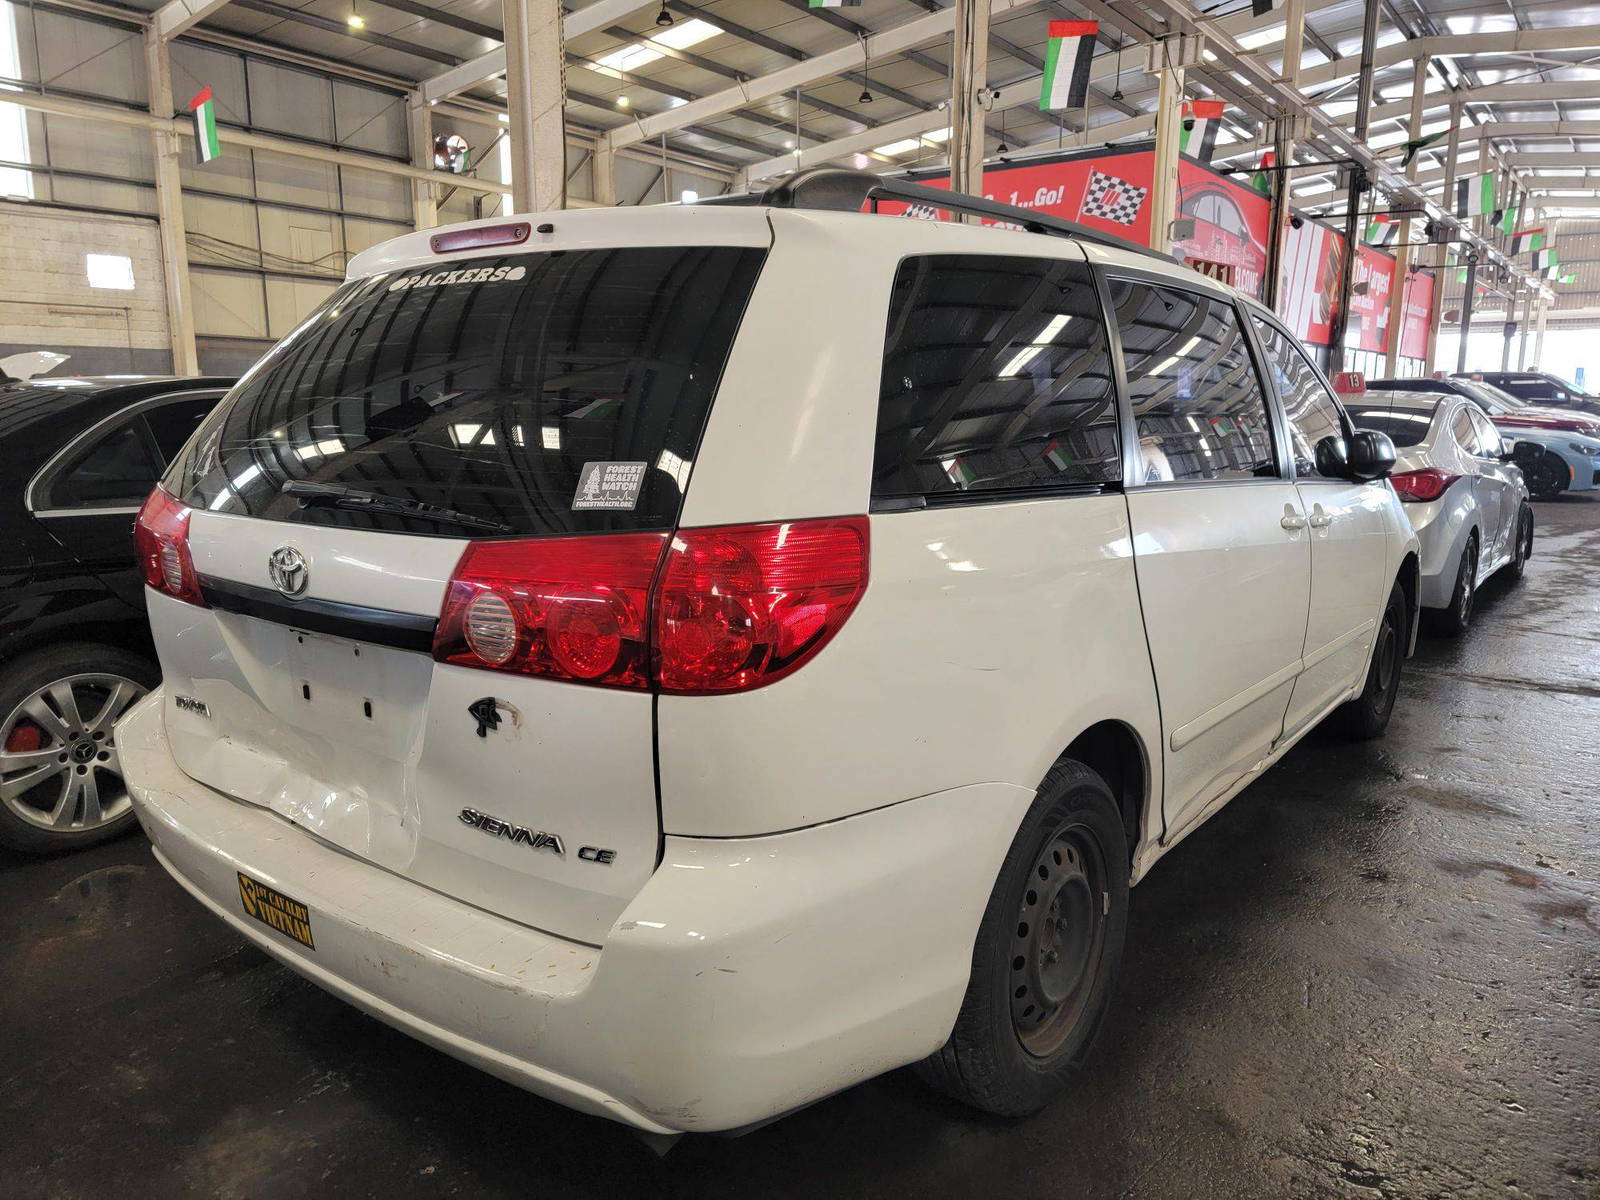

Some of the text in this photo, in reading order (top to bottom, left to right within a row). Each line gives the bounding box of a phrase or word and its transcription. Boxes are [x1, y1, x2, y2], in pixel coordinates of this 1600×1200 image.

[403, 266, 512, 290] PACKERS
[1349, 374, 1360, 388] 13
[605, 465, 643, 474] FOREST
[603, 473, 640, 482] HEALTH
[601, 481, 638, 491] WATCH
[457, 806, 617, 865] SIENNA CE
[256, 898, 315, 946] VIETNAM
